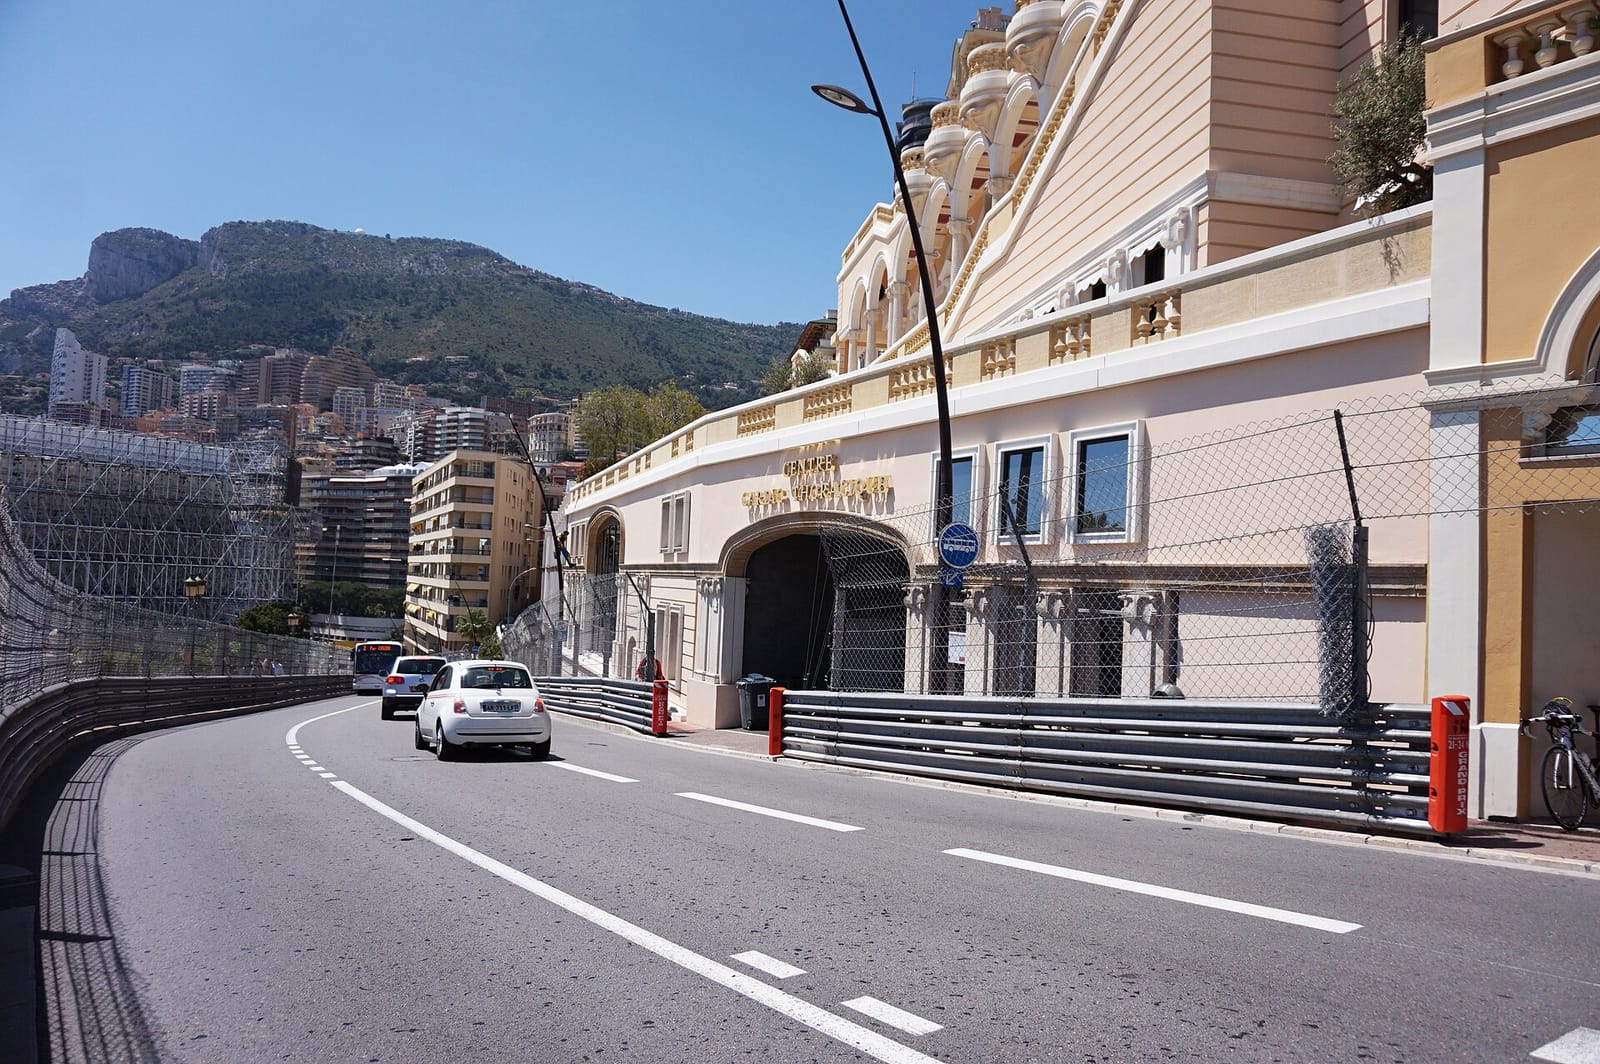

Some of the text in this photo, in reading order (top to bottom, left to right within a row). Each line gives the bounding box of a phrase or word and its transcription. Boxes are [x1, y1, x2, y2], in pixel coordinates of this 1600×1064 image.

[783, 454, 836, 477] CENTRE
[1457, 751, 1468, 785] GRAND
[1456, 787, 1466, 816] PRIX
